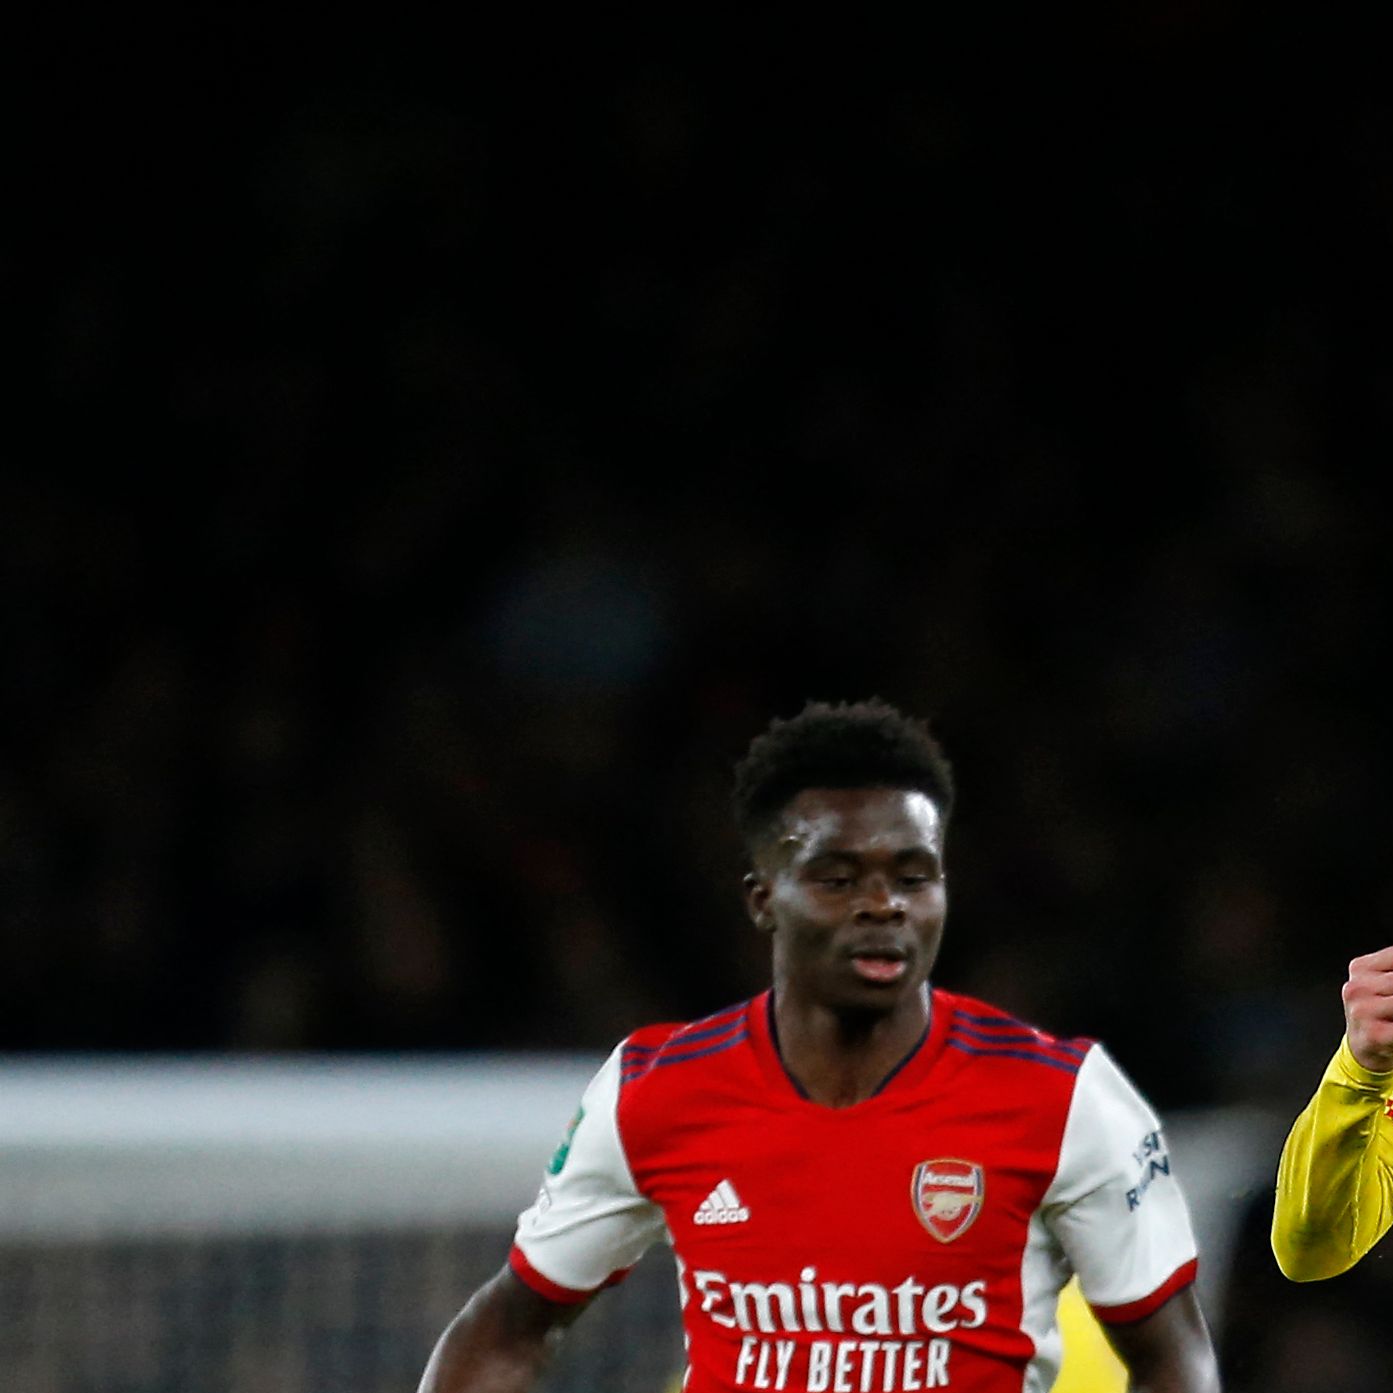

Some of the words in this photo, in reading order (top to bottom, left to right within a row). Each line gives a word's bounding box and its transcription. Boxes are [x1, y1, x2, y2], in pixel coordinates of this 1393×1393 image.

[694, 1207, 749, 1225] adidas
[693, 1266, 987, 1336] Emirates
[735, 1336, 796, 1391] FLY
[807, 1338, 951, 1393] BETTER
